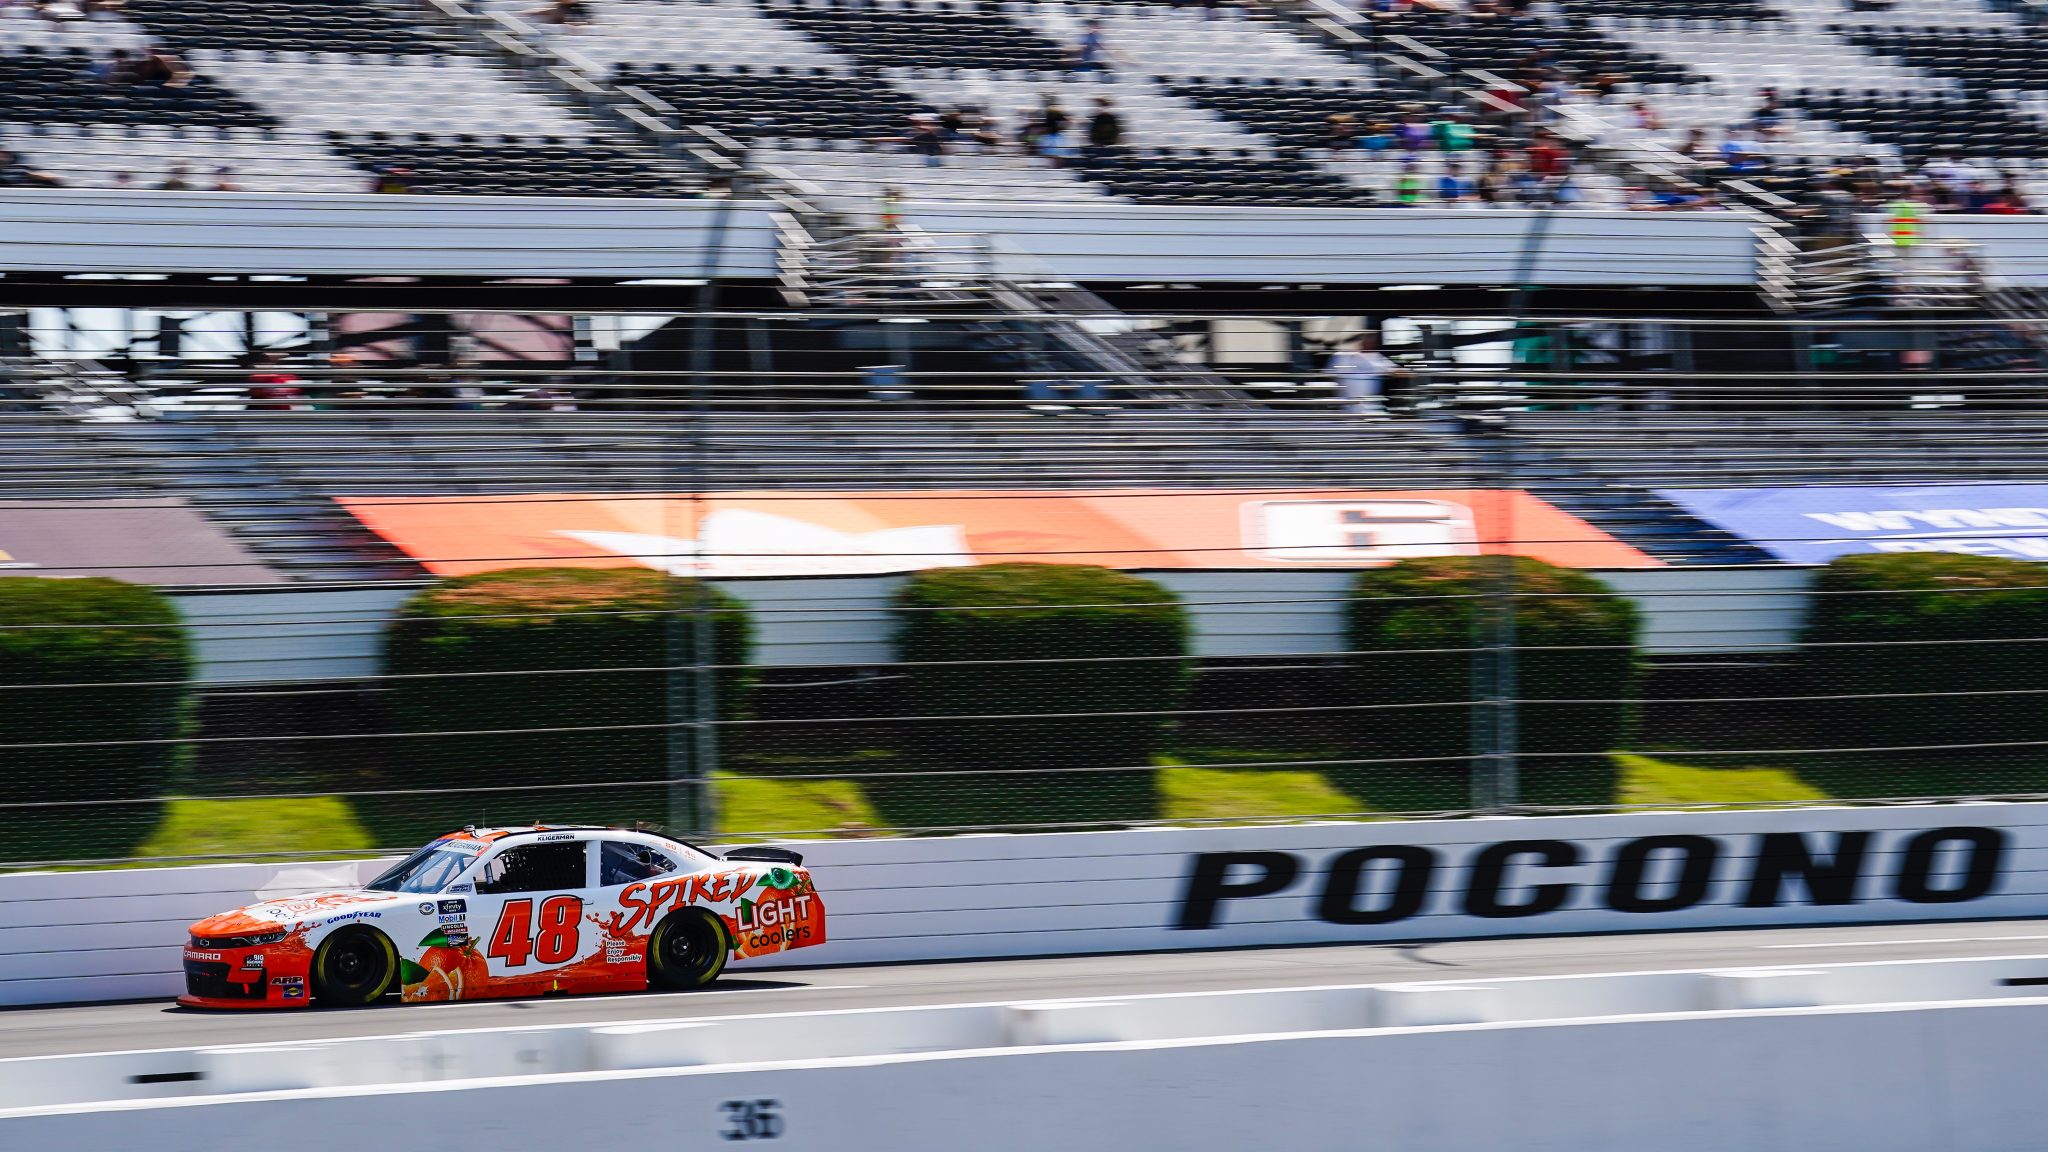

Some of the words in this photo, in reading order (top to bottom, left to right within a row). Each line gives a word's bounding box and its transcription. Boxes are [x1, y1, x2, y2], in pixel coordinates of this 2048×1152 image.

[1177, 826, 2008, 930] POCONO
[609, 872, 758, 937] SPIKED
[735, 894, 812, 932] LIGHT
[327, 911, 382, 924] GOODYEAR
[439, 915, 457, 923] Mobil
[487, 894, 583, 967] 48
[750, 926, 811, 948] coolers
[183, 950, 221, 960] CAMARO
[607, 955, 641, 963] Responsibly
[272, 976, 303, 985] ARP
[717, 1098, 786, 1141] 36
